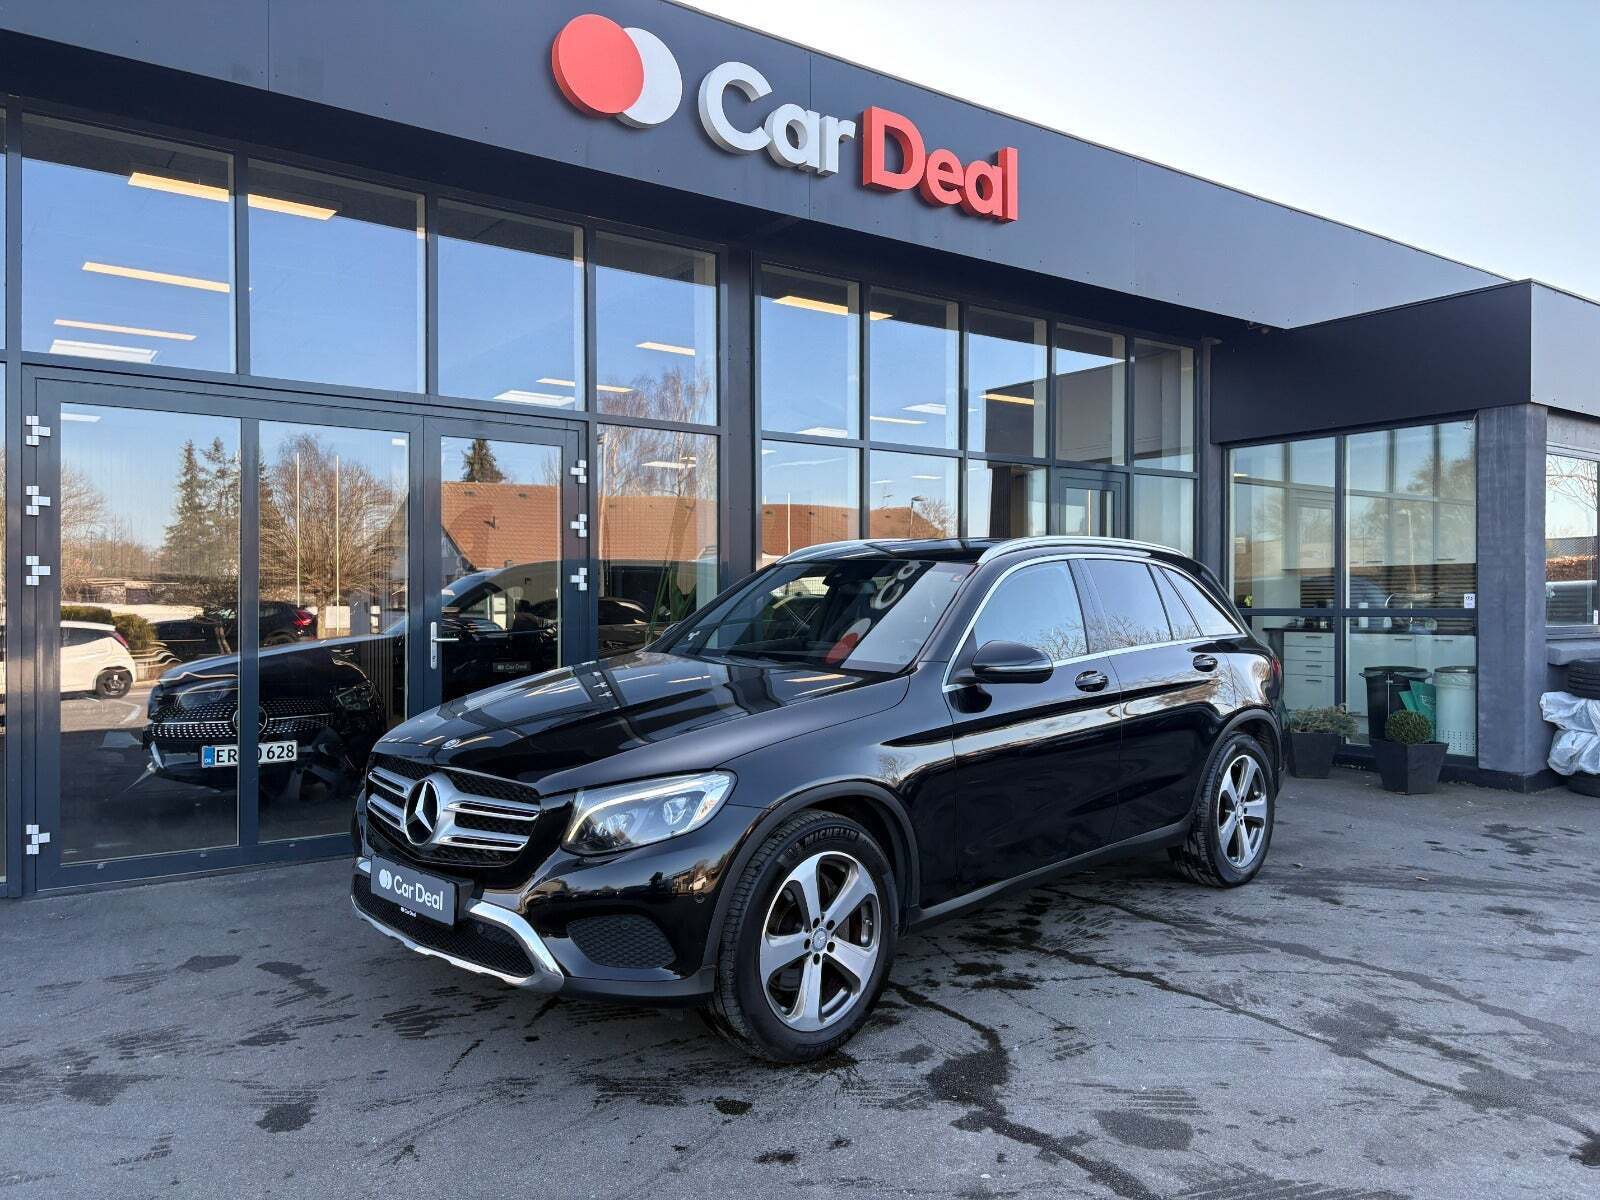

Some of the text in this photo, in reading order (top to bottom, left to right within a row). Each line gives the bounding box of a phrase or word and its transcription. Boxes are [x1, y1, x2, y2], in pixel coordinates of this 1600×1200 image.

[698, 61, 1018, 223] Car Deal
[216, 749, 238, 763] ER
[266, 744, 295, 760] 628
[805, 828, 858, 843] MICHELIN
[393, 875, 444, 911] Car Deal
